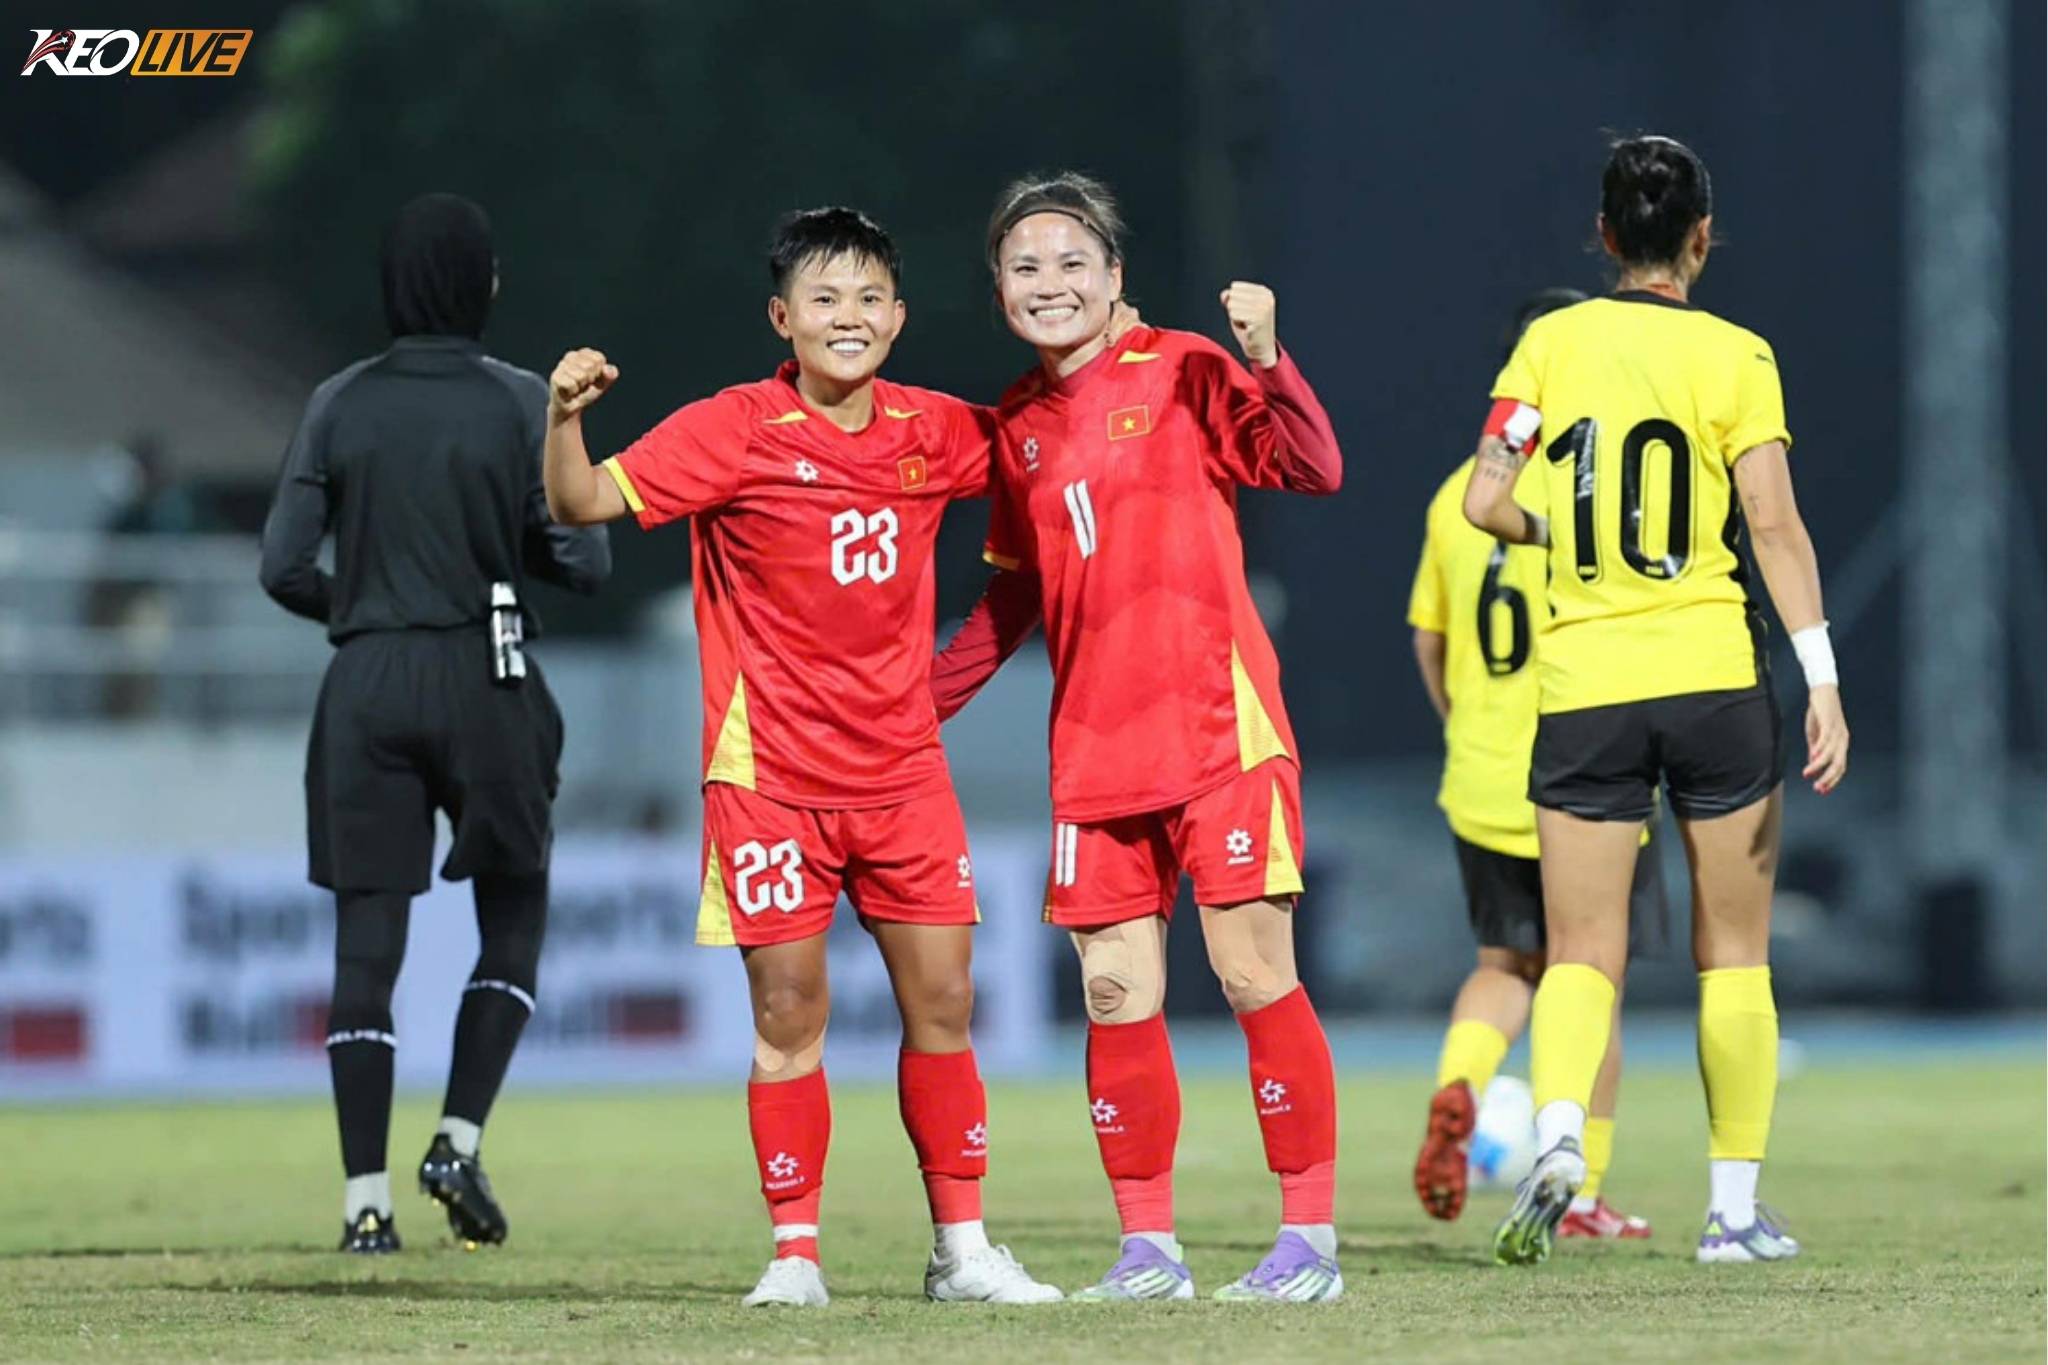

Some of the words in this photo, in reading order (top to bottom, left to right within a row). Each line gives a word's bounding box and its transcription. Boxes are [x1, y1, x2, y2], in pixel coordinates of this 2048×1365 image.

[1062, 478, 1097, 560] 11
[1545, 416, 1692, 583] 10
[831, 507, 899, 586] 23
[1476, 542, 1532, 678] 6
[734, 838, 804, 916] 23
[1055, 822, 1078, 887] 11
